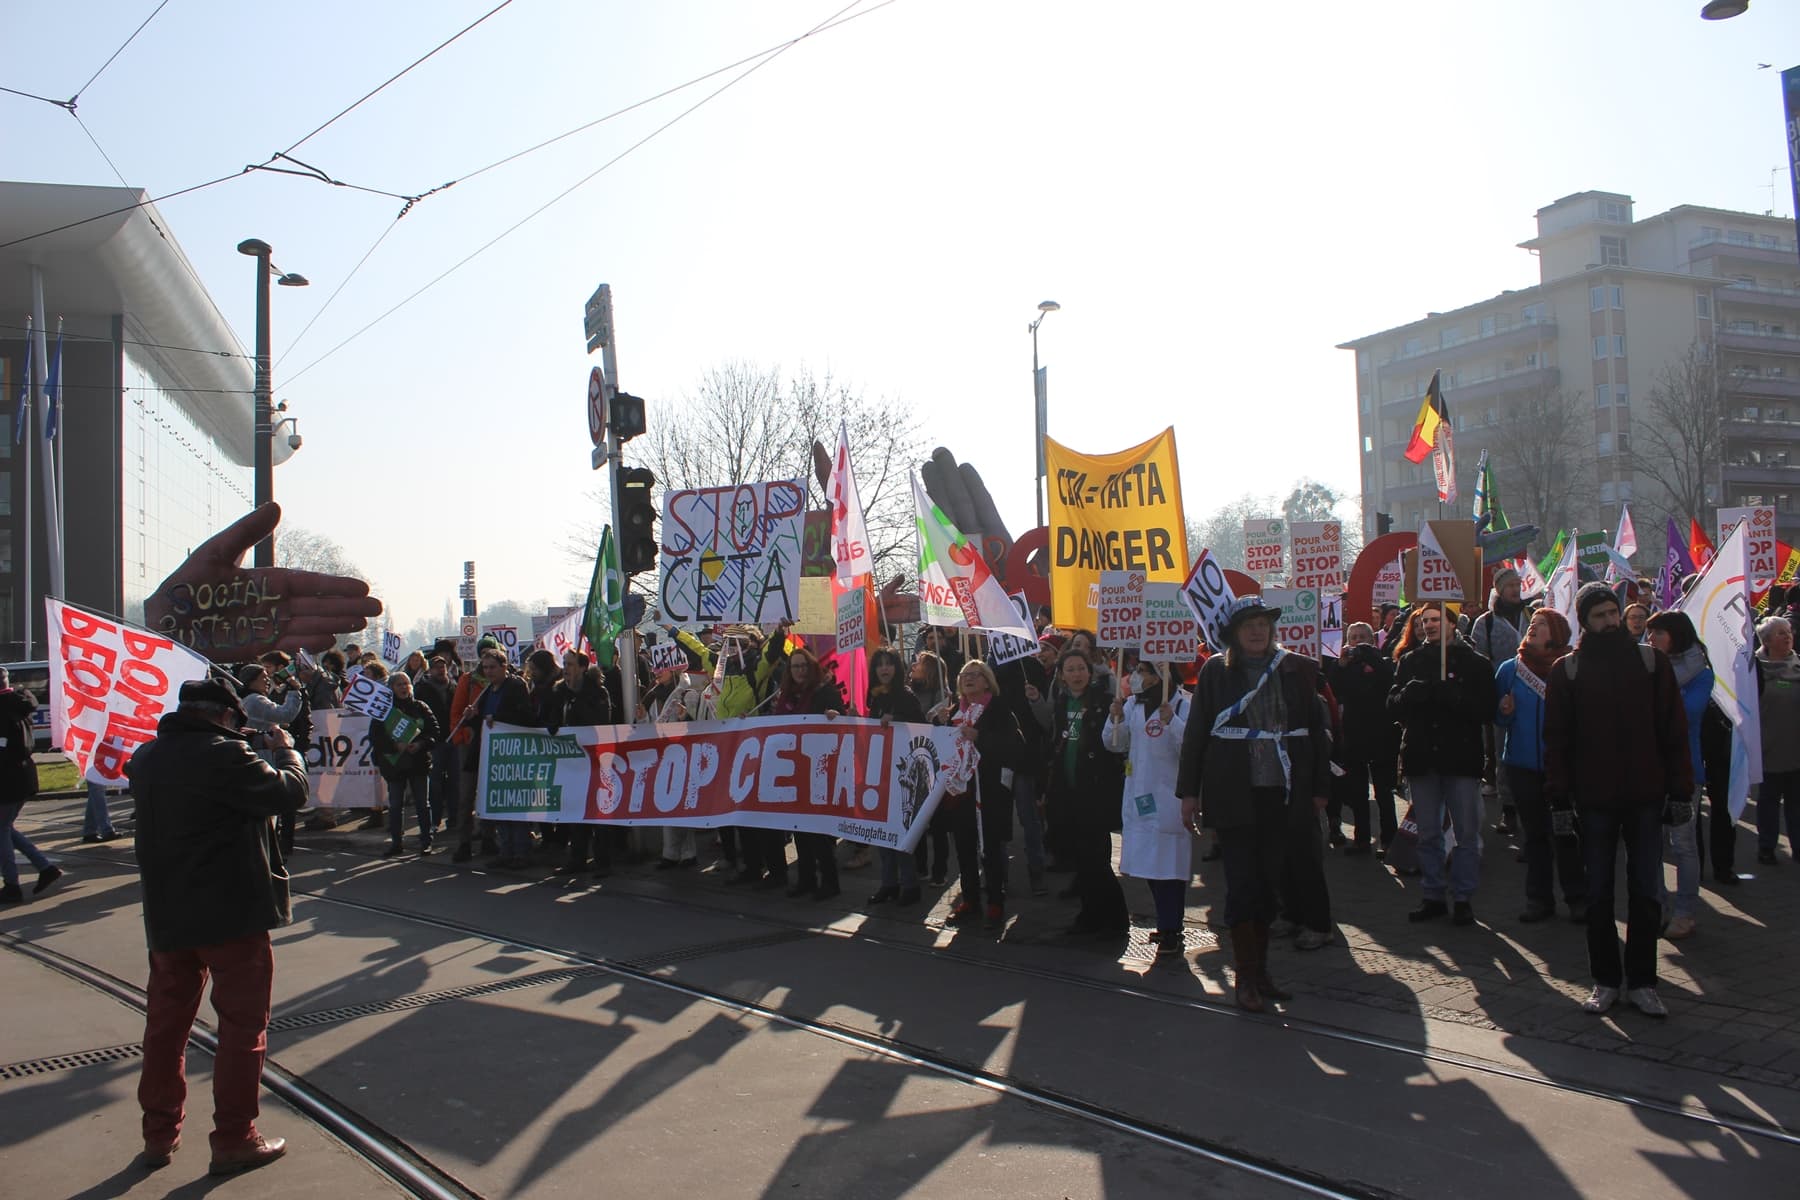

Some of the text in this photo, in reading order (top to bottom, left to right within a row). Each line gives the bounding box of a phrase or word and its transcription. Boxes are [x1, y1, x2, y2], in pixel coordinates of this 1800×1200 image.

[661, 481, 803, 556] STOP
[1056, 526, 1175, 571] DANGER
[1294, 536, 1320, 546] POUR
[1295, 543, 1340, 555] LA SANTÉ
[1247, 545, 1281, 558] STOP
[1247, 557, 1282, 571] CETA!
[1296, 555, 1340, 572] STOP
[1423, 559, 1452, 574] STO
[663, 550, 793, 623] CETA
[1295, 571, 1340, 588] CETA!
[167, 576, 281, 614] SOCIAL
[1102, 586, 1125, 595] POUR
[1187, 558, 1224, 620] NO
[1102, 597, 1112, 605] LA
[1146, 600, 1174, 608] POUR
[1101, 607, 1141, 623] STOP
[1146, 610, 1156, 618] LE
[839, 615, 862, 635] STOP
[1100, 624, 1141, 641] CETA!
[1146, 620, 1194, 636] STOP
[1277, 625, 1315, 641] TOP
[385, 632, 401, 650] NO
[839, 630, 864, 649] CETA!
[1143, 639, 1194, 654] CETA!
[344, 678, 375, 712] NO
[367, 689, 394, 720] CETA
[392, 718, 409, 738] CETA
[491, 738, 520, 756] POUR
[523, 738, 538, 756] LA
[490, 763, 552, 781] SOCIALE ET
[596, 733, 885, 815] STOP CETA!
[489, 788, 551, 807] CLIMATIQUE
